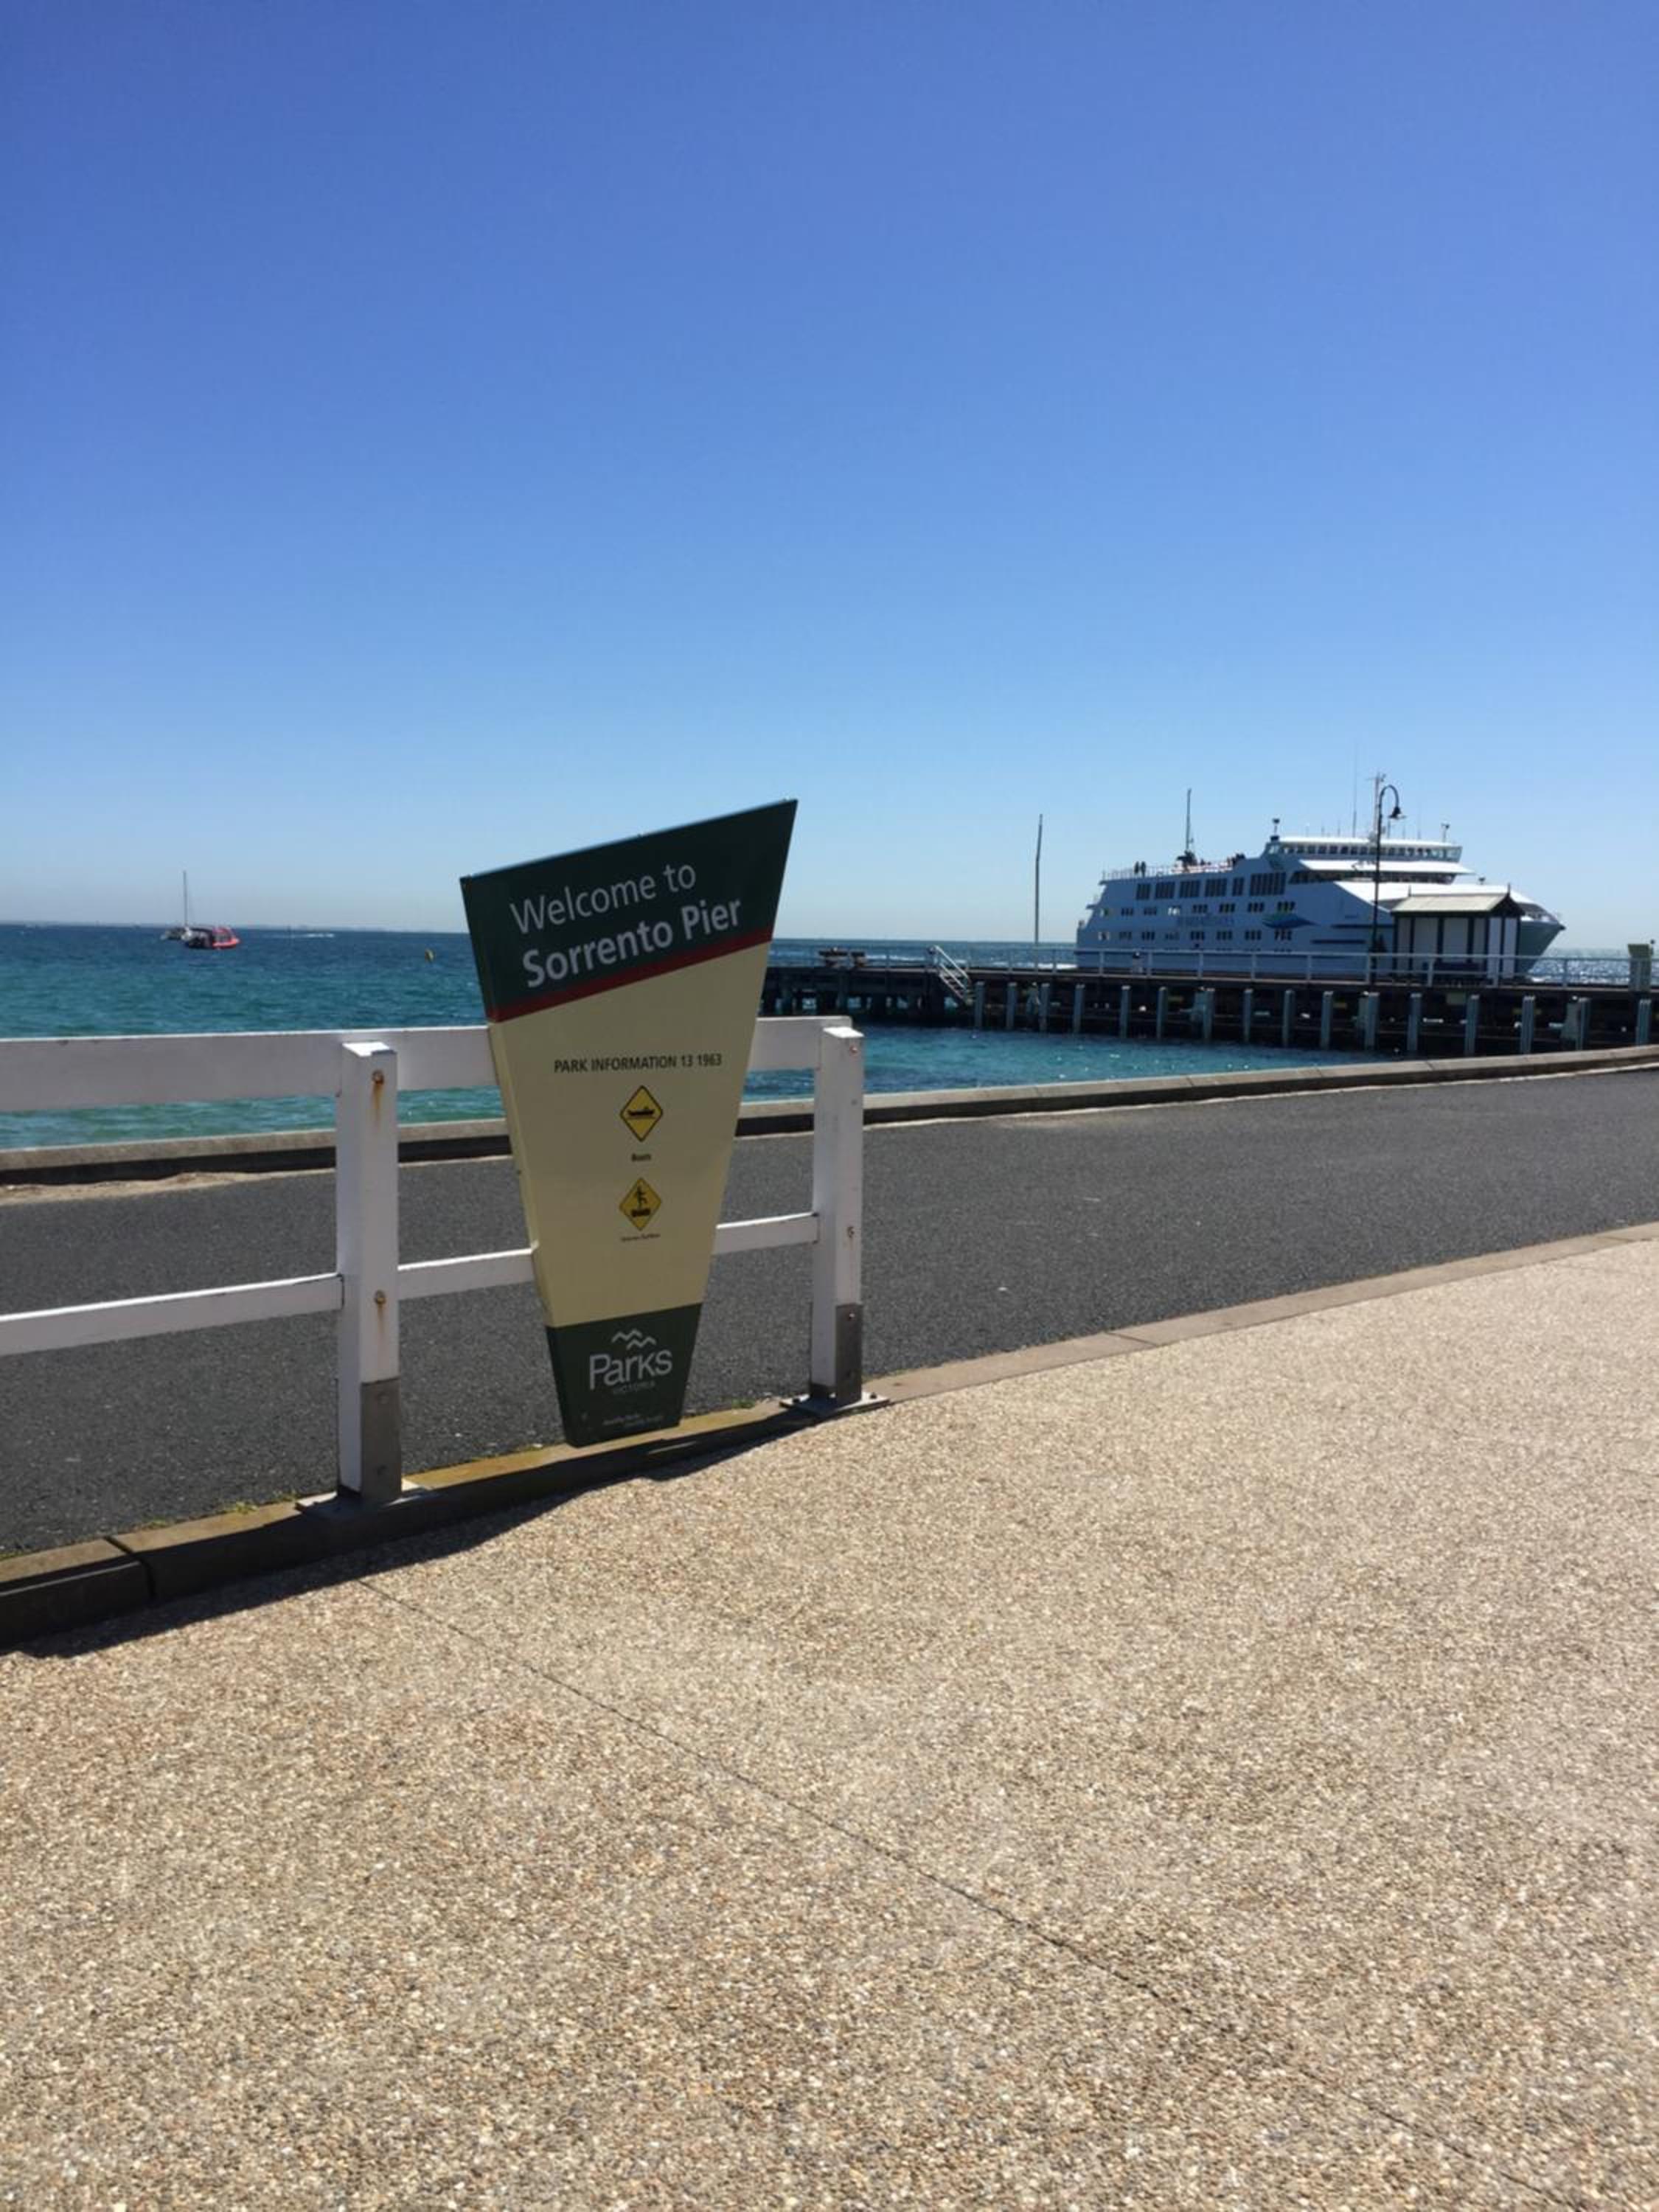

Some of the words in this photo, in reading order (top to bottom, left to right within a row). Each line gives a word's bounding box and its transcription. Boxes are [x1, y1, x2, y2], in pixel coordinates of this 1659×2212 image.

[509, 873, 656, 935] Welcome
[664, 863, 697, 893] to
[522, 920, 673, 988] Sorrento
[681, 899, 742, 940] Pier
[554, 1059, 588, 1073] PARK
[591, 1055, 676, 1071] INFORMATION
[681, 1054, 693, 1068] 13
[698, 1053, 722, 1067] 1963
[589, 1349, 673, 1391] Parks
